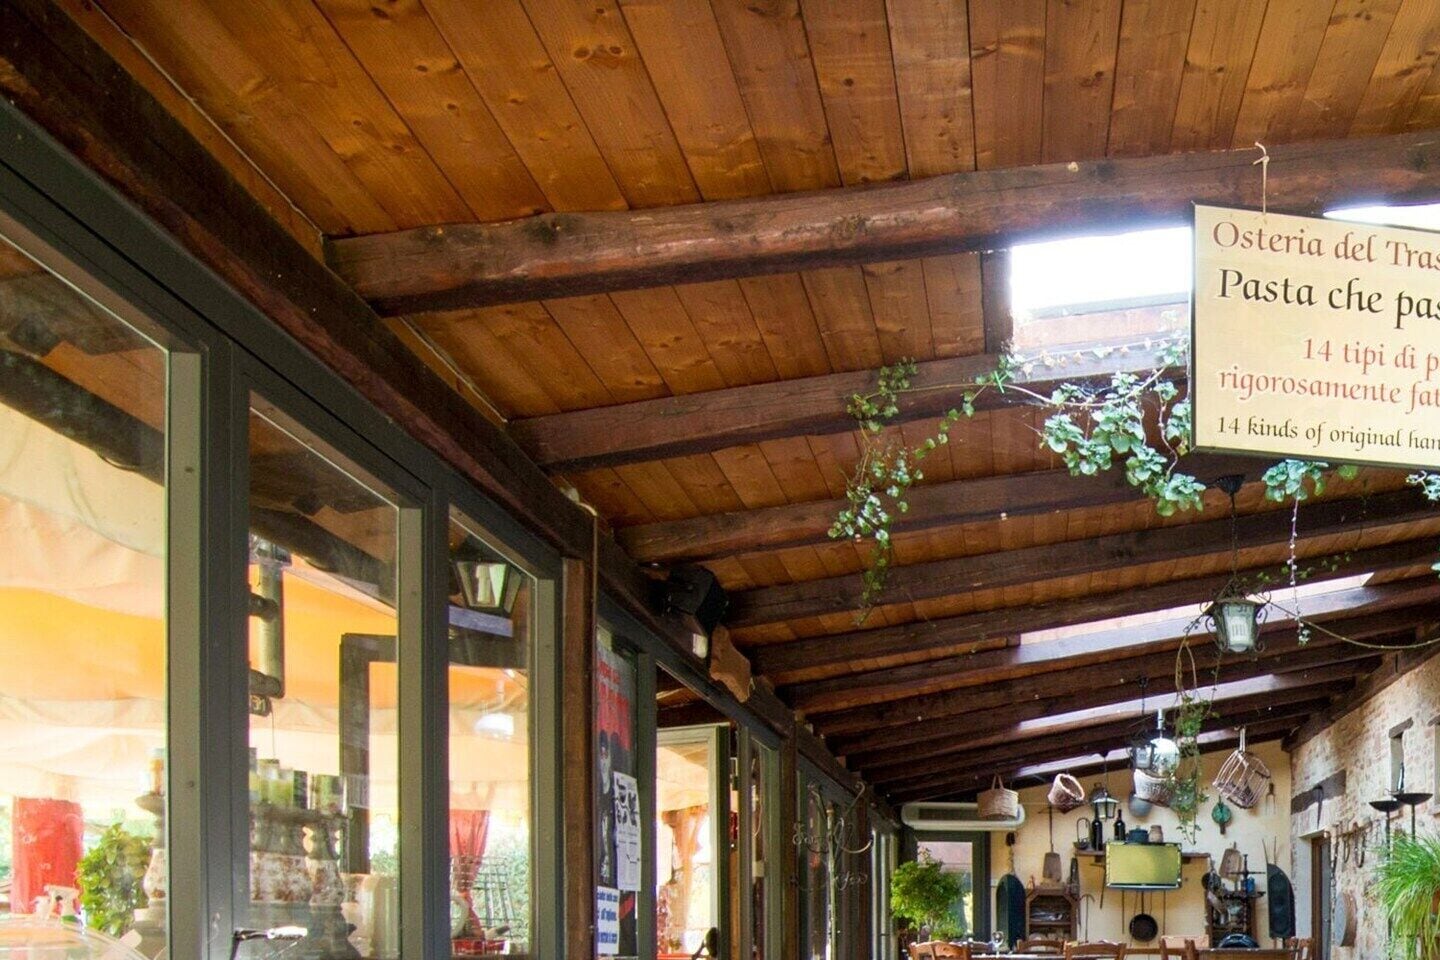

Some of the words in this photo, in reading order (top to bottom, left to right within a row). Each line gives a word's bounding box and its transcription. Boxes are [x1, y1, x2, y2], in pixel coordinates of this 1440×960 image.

[1213, 221, 1326, 257] Osteria
[1334, 231, 1377, 263] del
[1217, 268, 1318, 306] Pasta
[1328, 277, 1385, 314] che
[1303, 338, 1333, 363] 14
[1343, 341, 1386, 375] tipi
[1394, 344, 1418, 369] di
[1219, 365, 1401, 404] rigorosamente
[1217, 416, 1240, 435] 14
[1248, 415, 1298, 439] kinds
[1305, 421, 1327, 448] of
[1329, 426, 1402, 452] original
